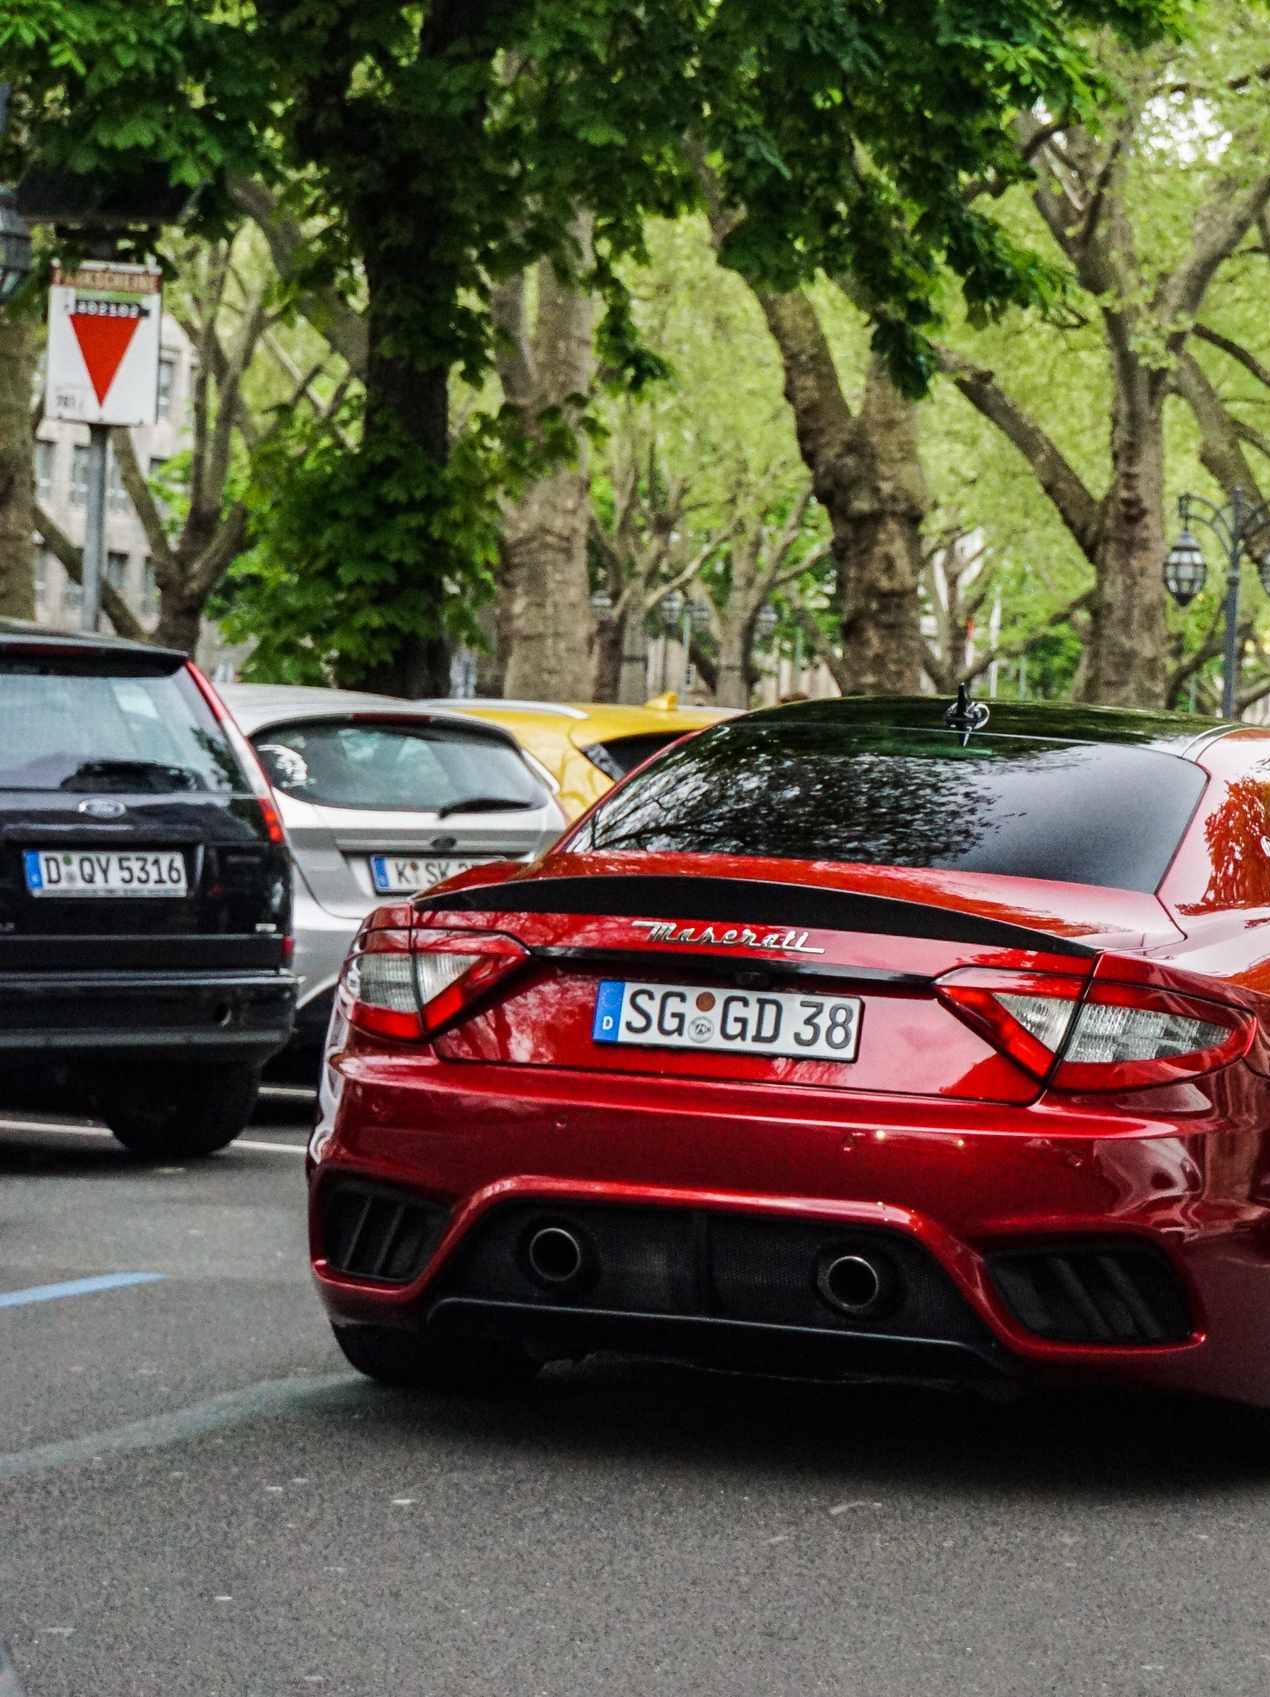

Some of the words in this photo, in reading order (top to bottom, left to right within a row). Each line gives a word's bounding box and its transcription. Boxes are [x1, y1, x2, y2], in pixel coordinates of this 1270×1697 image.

[45, 857, 61, 884] D
[79, 856, 110, 884] QY
[118, 857, 181, 884] 5316
[395, 862, 410, 884] K
[631, 920, 825, 954] Maserati
[625, 988, 687, 1037] SG
[720, 995, 783, 1043] GD
[793, 1001, 854, 1049] 38
